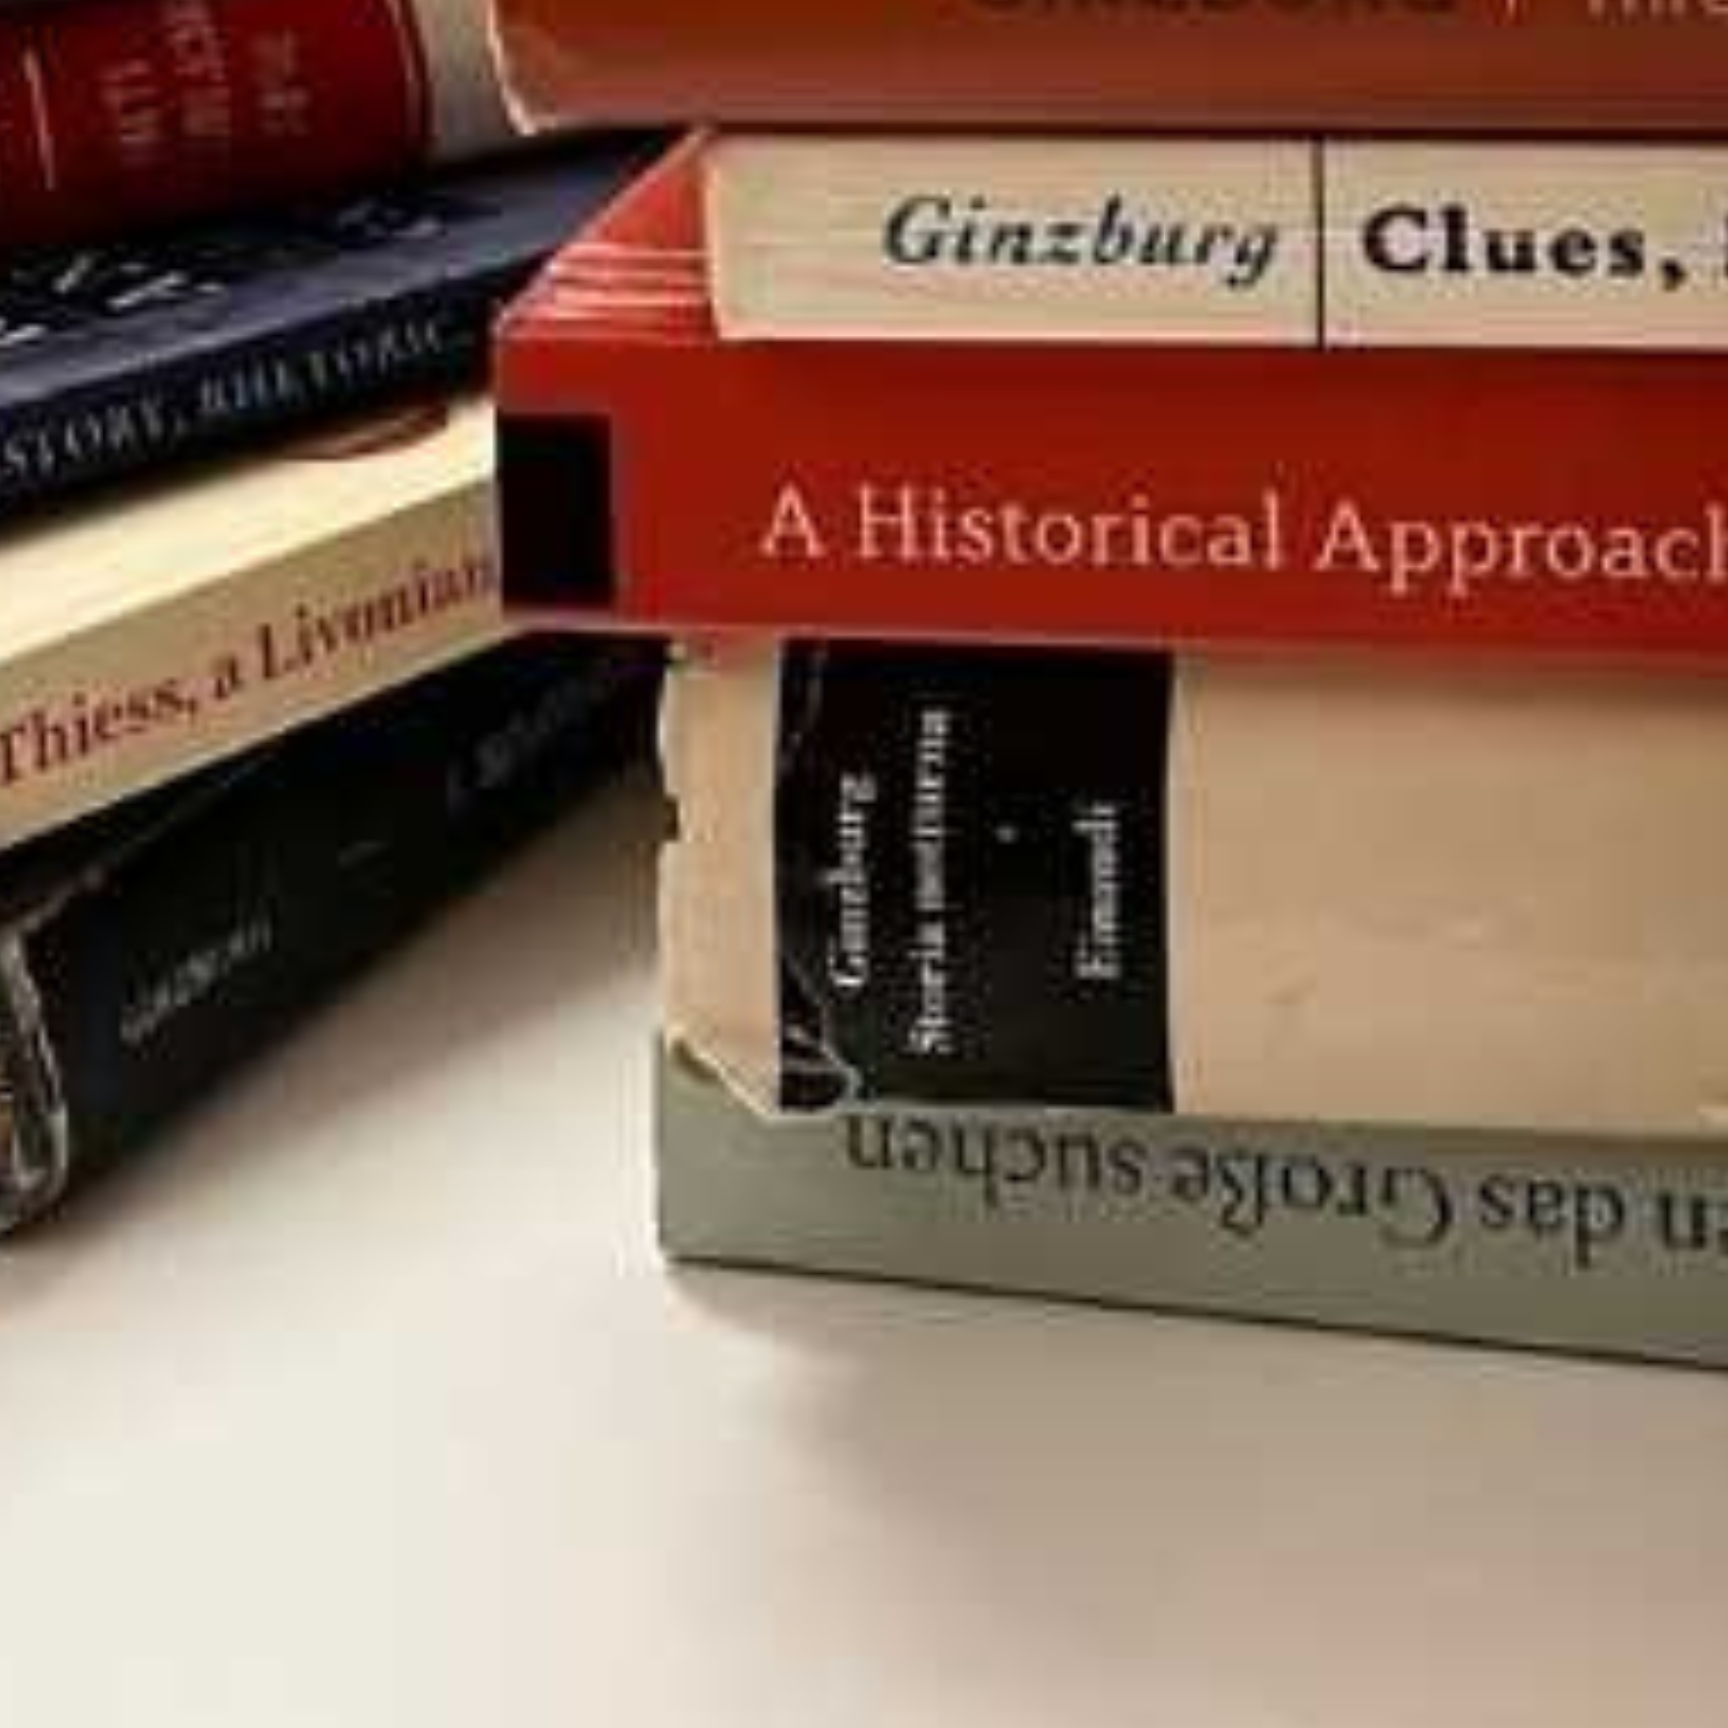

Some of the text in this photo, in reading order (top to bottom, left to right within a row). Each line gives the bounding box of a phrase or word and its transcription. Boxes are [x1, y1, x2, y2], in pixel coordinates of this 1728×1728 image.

[881, 193, 1280, 285] Ginzburg
[1360, 205, 1686, 290] Clues,
[758, 483, 824, 560] A
[855, 484, 1285, 570] Historical
[213, 655, 244, 701] a
[259, 555, 497, 682] Livonian
[822, 772, 878, 988] Ginzburg
[906, 708, 954, 1056] Storia notturna
[844, 1114, 1144, 1210] suchen
[1170, 1140, 1456, 1250] Große
[1479, 1173, 1627, 1268] das
